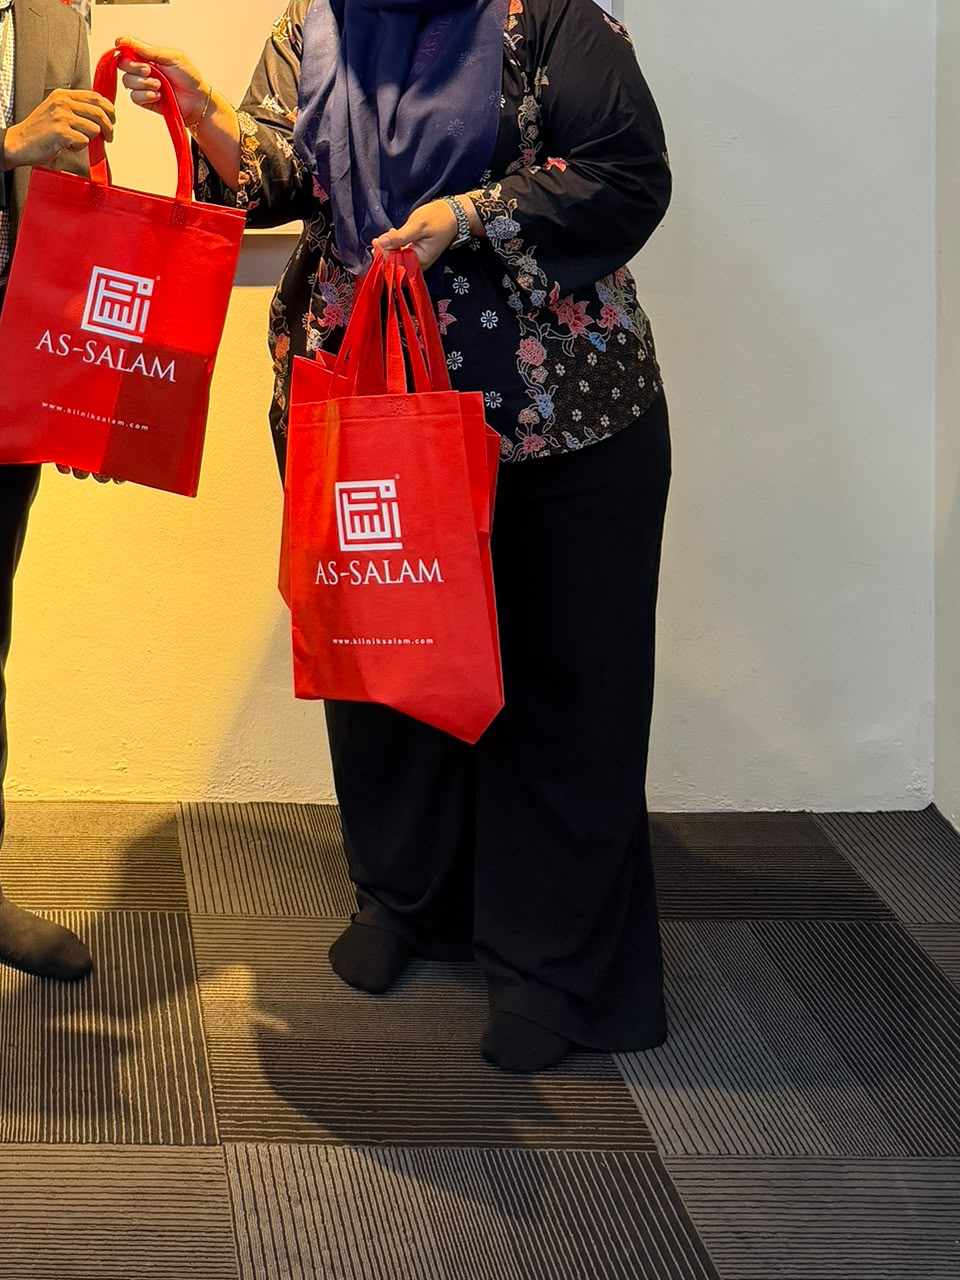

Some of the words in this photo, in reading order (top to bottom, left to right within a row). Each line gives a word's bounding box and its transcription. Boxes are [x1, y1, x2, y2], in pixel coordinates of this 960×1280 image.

[35, 329, 176, 383] AS-SALAM
[41, 400, 149, 432] www.kliniksalam.com
[315, 558, 444, 586] AS-SALAM
[332, 637, 434, 646] www.kliniksalam.com
